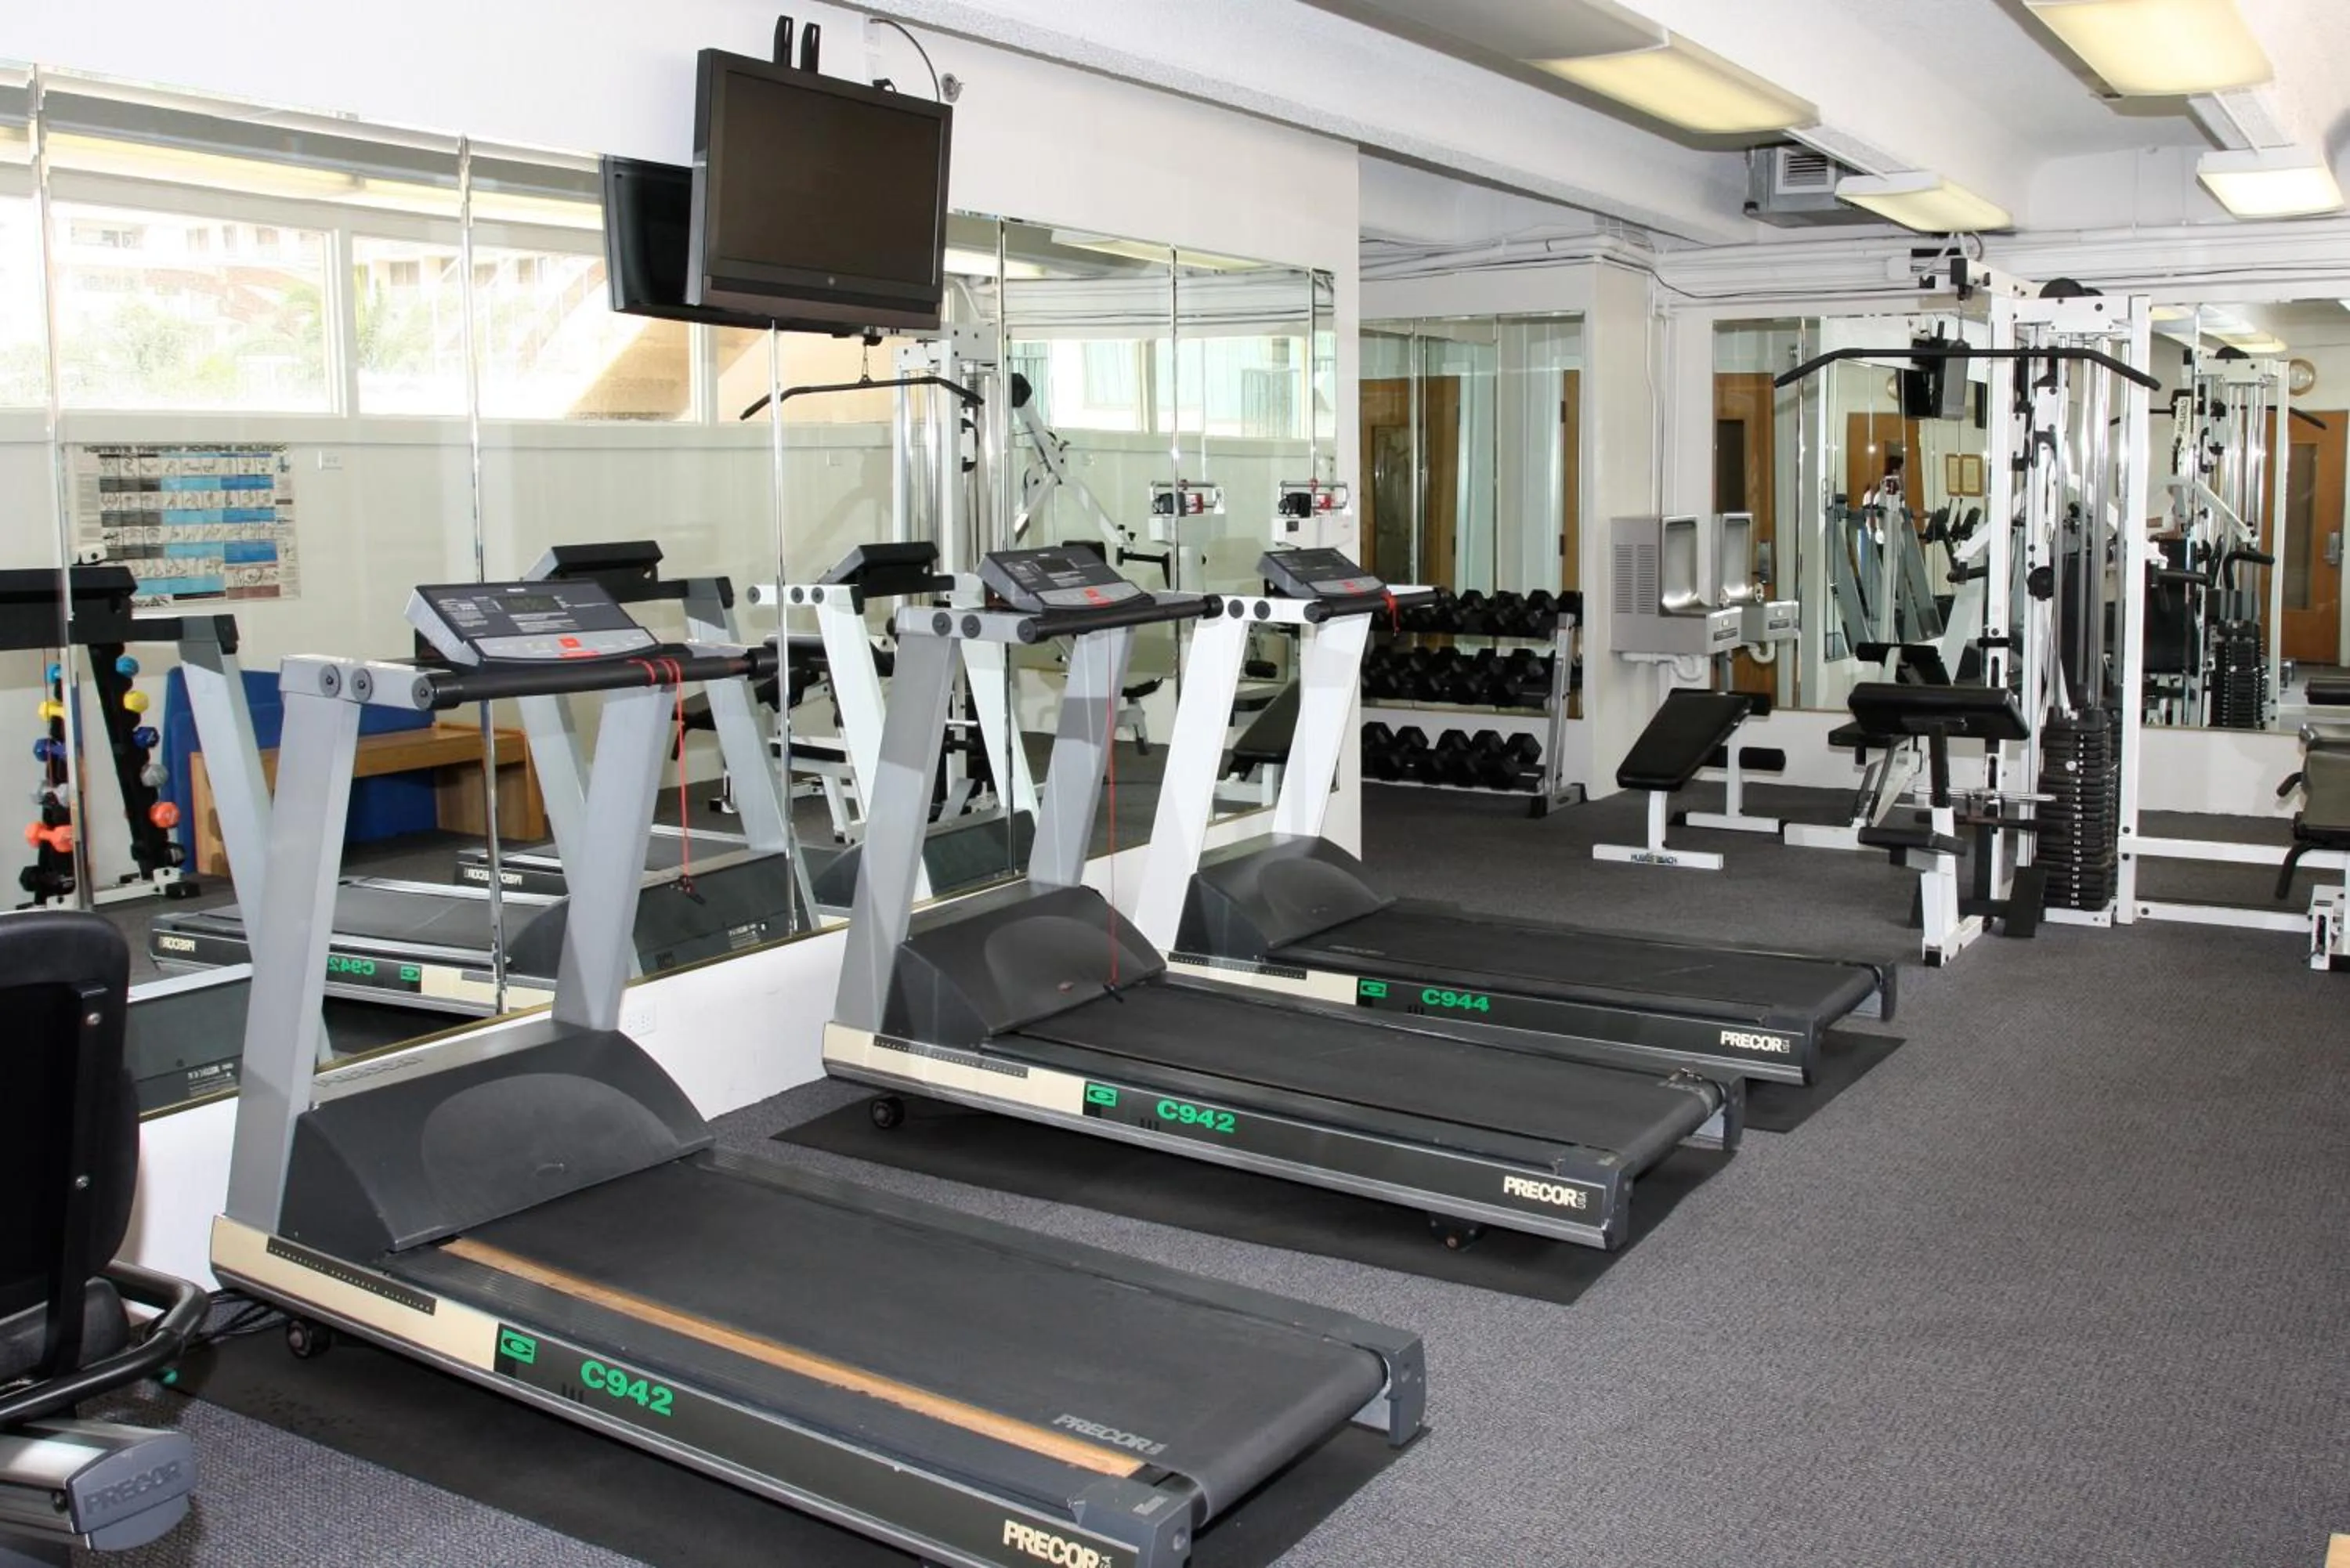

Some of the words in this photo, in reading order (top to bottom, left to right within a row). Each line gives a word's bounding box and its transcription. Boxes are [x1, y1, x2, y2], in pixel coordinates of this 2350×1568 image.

[1421, 988, 1490, 1013] C944
[1720, 1030, 1782, 1053] PRECOR
[1155, 1099, 1236, 1134] C942
[1503, 1175, 1577, 1208] PRECOR
[580, 1359, 674, 1418] C942
[1052, 1413, 1153, 1451] PRECOR
[83, 1458, 183, 1515] PRECOR
[1002, 1519, 1100, 1568] PRECOR
